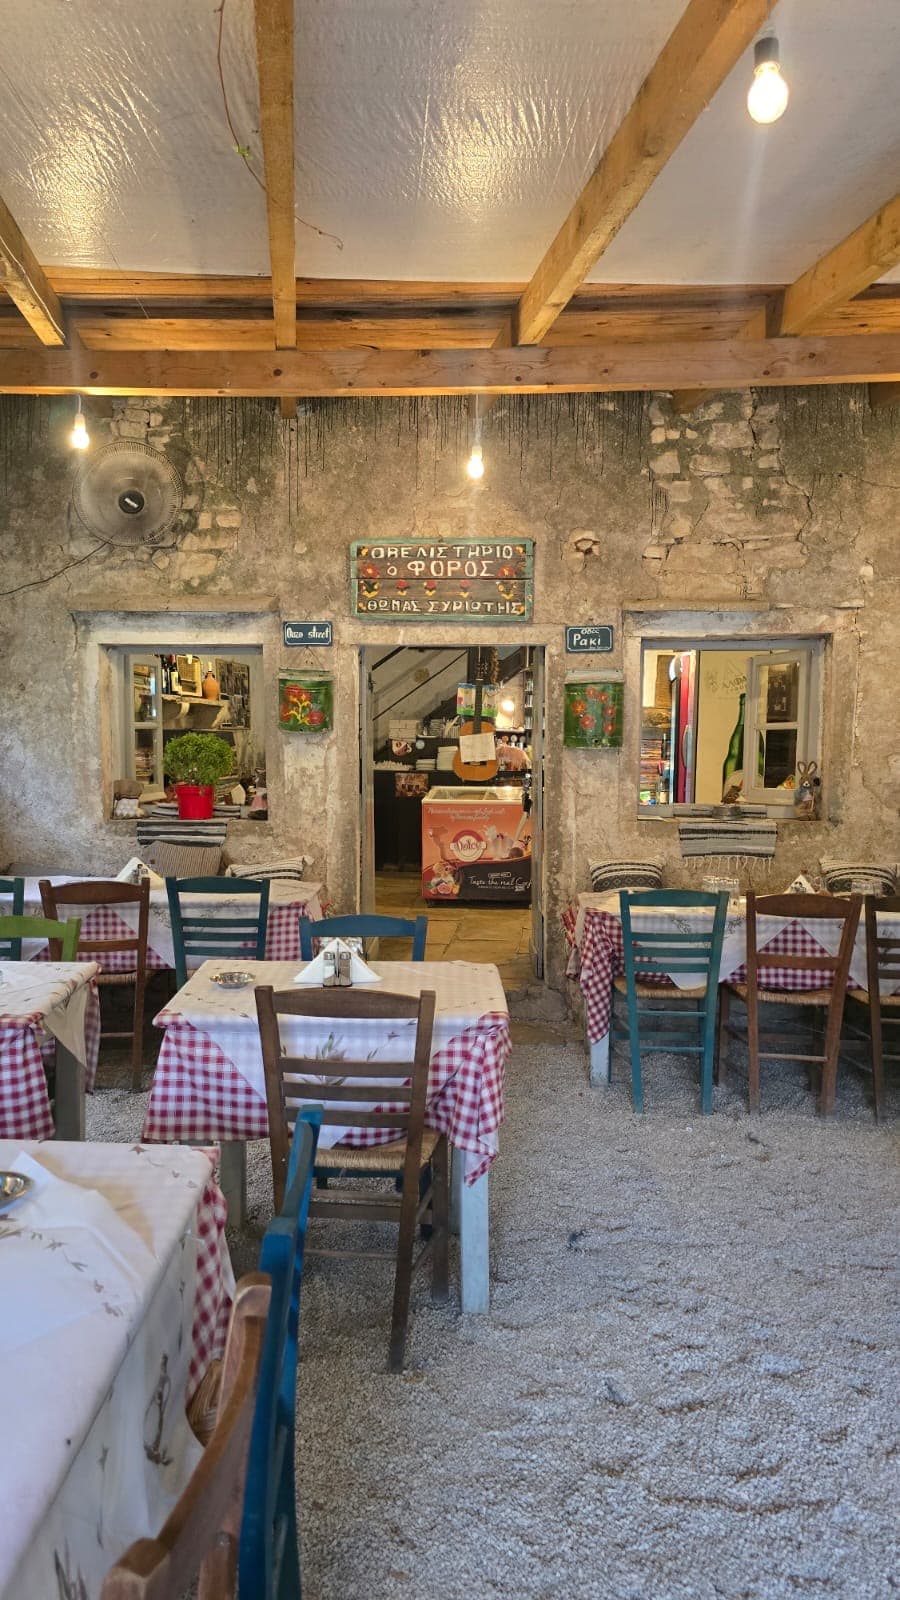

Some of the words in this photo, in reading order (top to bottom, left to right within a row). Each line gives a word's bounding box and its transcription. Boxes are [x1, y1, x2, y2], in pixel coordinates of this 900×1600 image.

[406, 560, 496, 577] ΦΟΡΟΣ
[427, 600, 523, 614] ΣΥΡΙΩΤΗΣ
[308, 625, 330, 638] street
